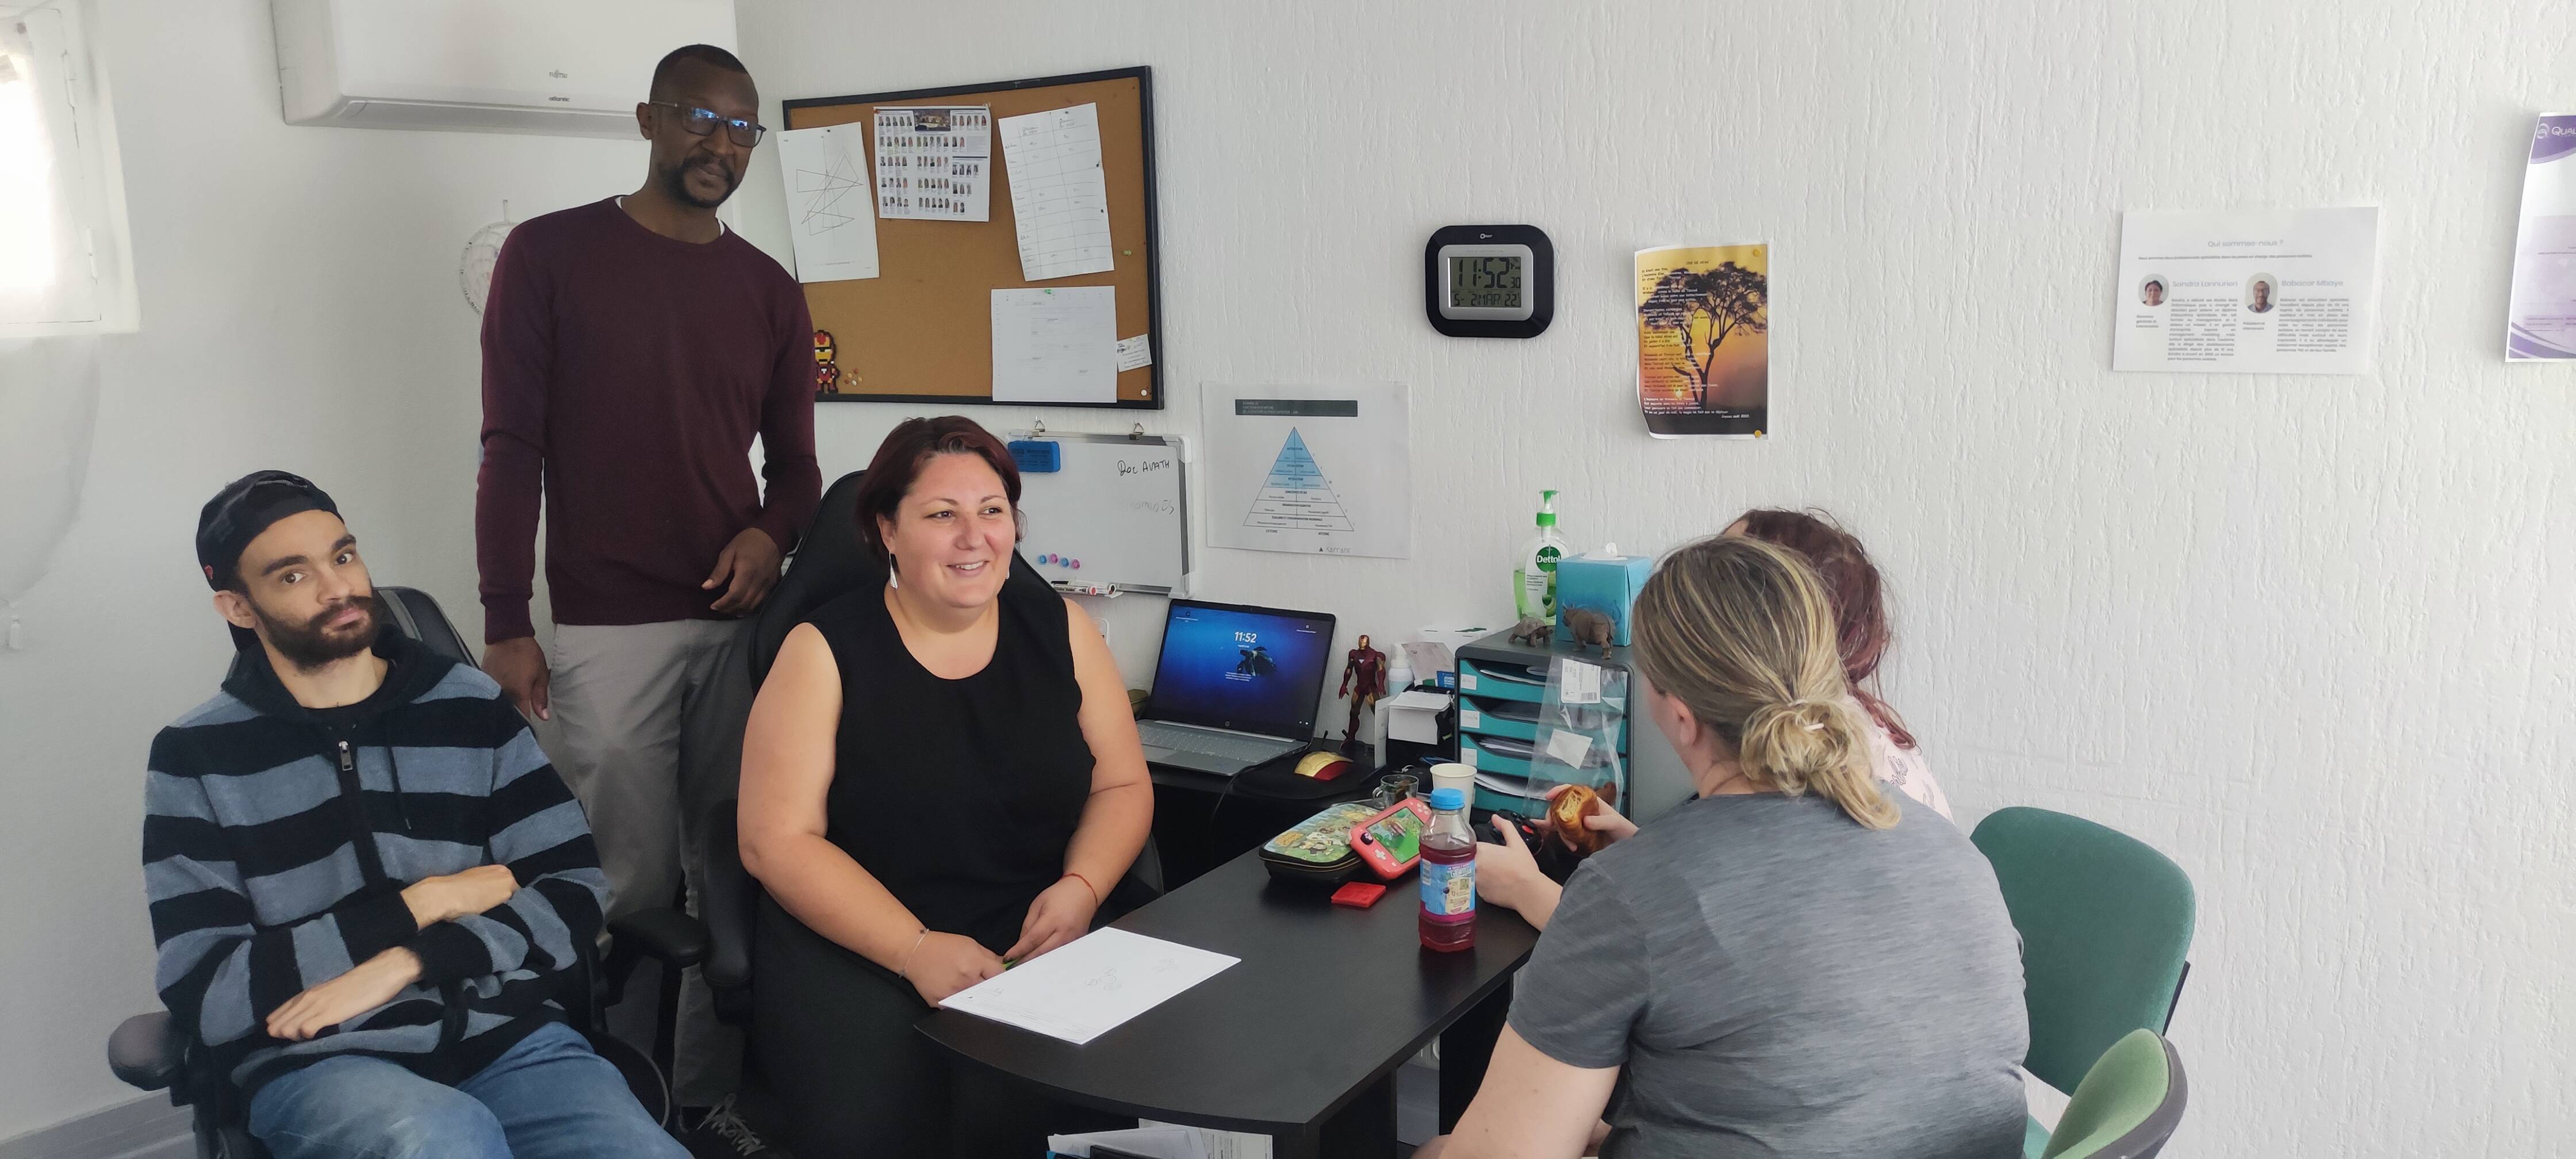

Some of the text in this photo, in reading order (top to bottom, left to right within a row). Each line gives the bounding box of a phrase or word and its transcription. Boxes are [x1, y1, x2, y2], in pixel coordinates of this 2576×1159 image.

[1459, 257, 1509, 288] 11:52
[1511, 277, 1521, 288] 30
[1536, 555, 1561, 563] Dettol
[1235, 631, 1257, 643] 11:52
